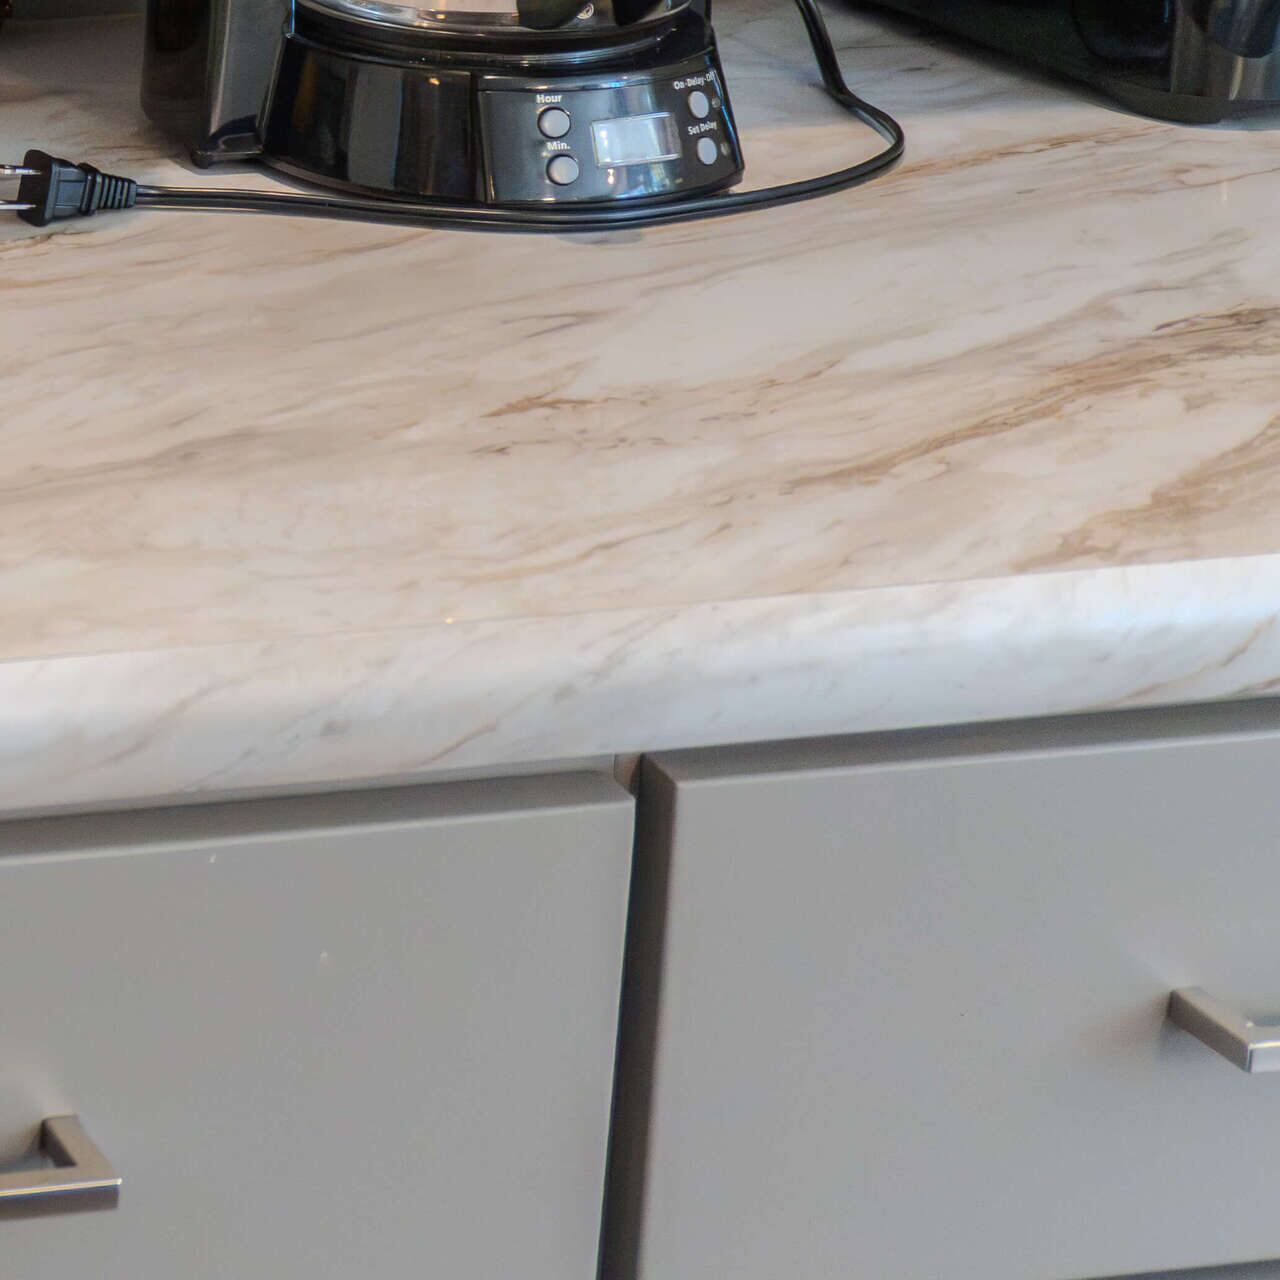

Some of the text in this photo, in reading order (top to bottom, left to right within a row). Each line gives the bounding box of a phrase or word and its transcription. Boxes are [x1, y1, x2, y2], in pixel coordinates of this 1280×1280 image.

[536, 94, 562, 104] Hour
[688, 124, 700, 135] Set
[546, 140, 571, 150] Min.
